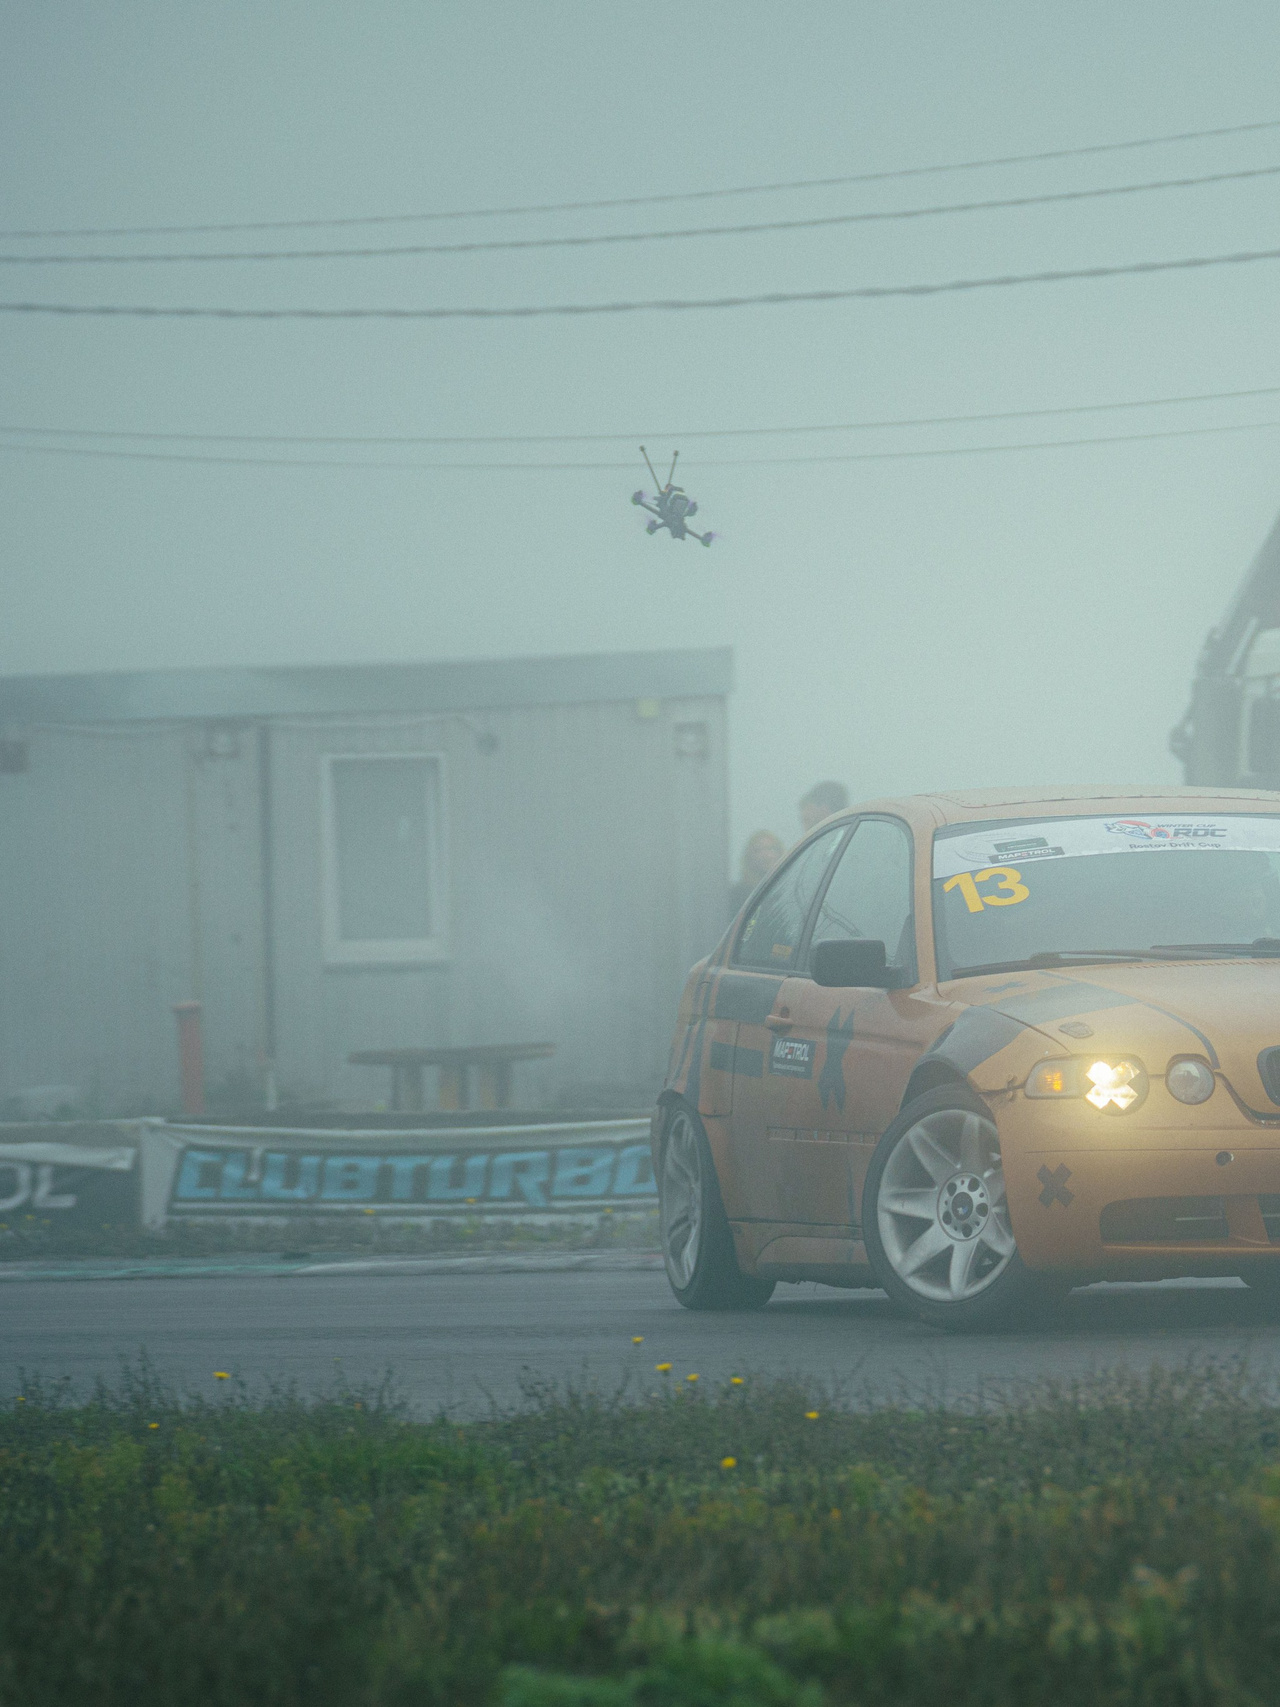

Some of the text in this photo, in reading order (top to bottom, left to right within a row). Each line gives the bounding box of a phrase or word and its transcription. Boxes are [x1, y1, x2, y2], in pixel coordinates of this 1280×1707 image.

[1173, 828, 1228, 838] RDC
[998, 848, 1056, 860] MAPETROL
[943, 867, 1030, 913] 13
[773, 1040, 810, 1062] MAPETROL
